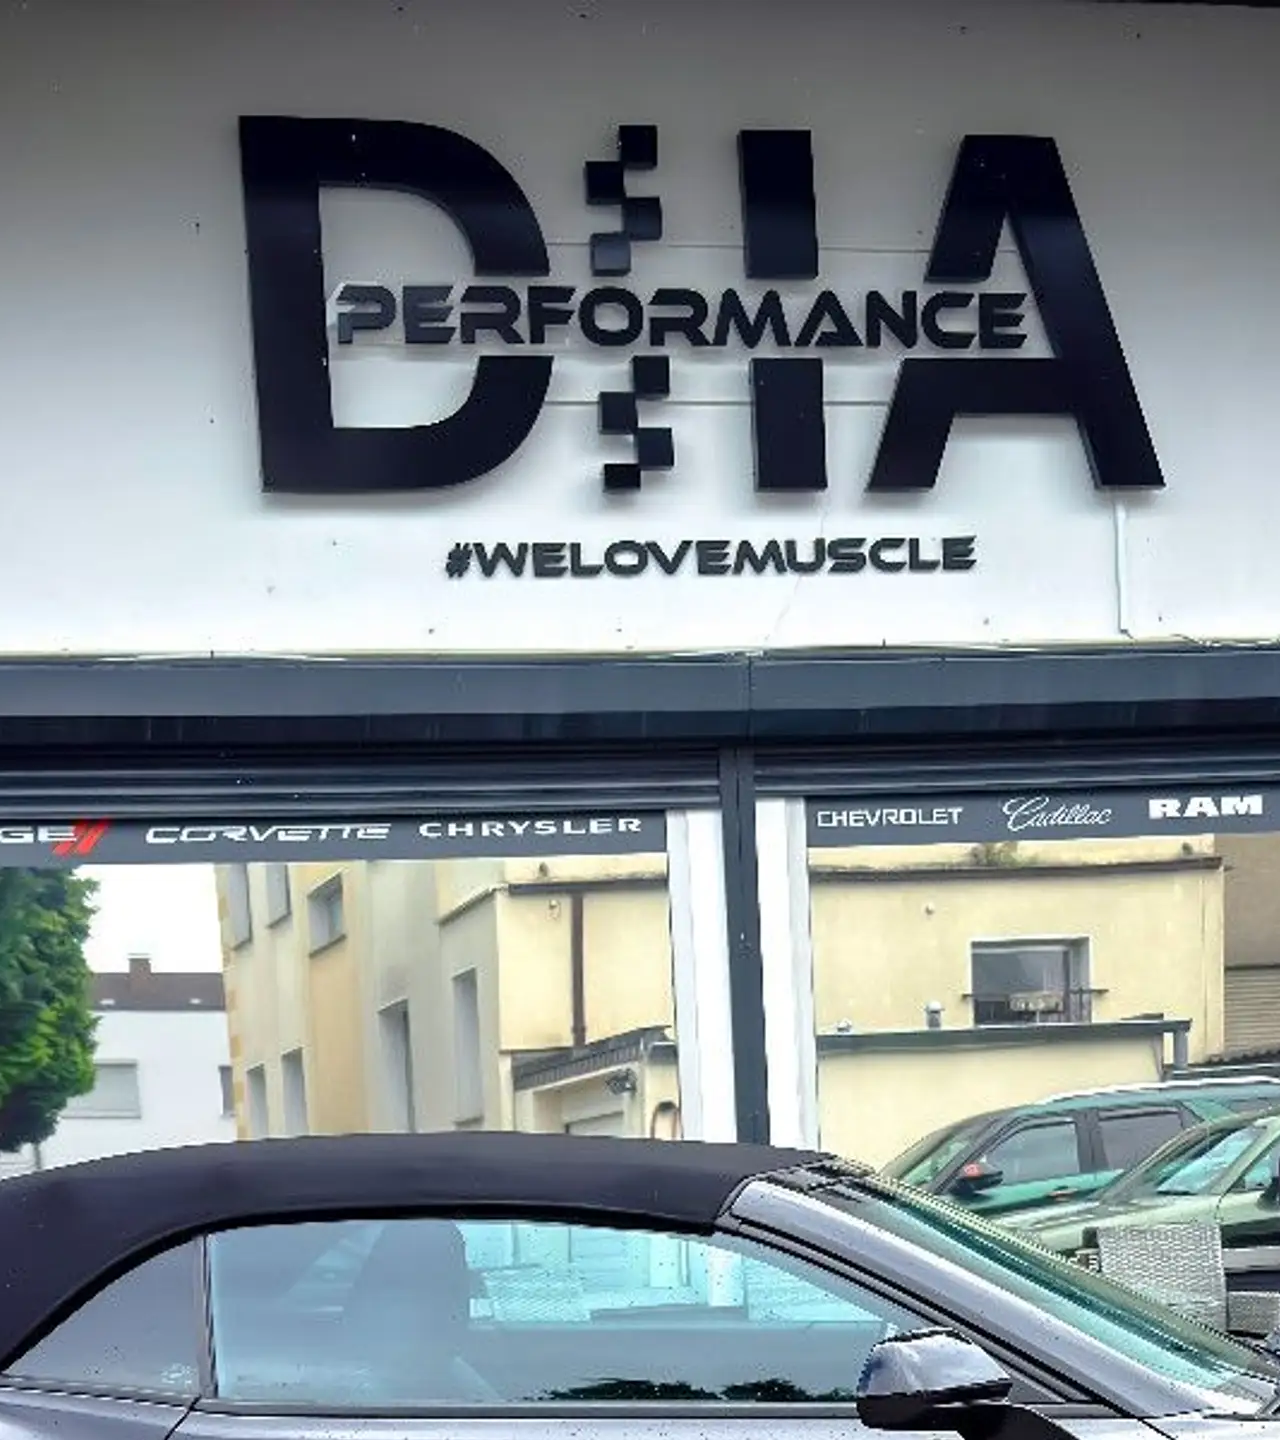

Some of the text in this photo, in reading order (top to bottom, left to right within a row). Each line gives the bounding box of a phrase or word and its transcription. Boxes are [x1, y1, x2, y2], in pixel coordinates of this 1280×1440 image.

[336, 285, 1028, 348] PERFORMANCE
[445, 536, 977, 578] #WELOVEMUSCLE
[146, 824, 392, 844] CORVETTE
[420, 818, 642, 837] CHRYSLER
[817, 807, 964, 827] CHEVROLET
[1002, 796, 1113, 831] Cadillac
[1149, 795, 1263, 819] RAM
